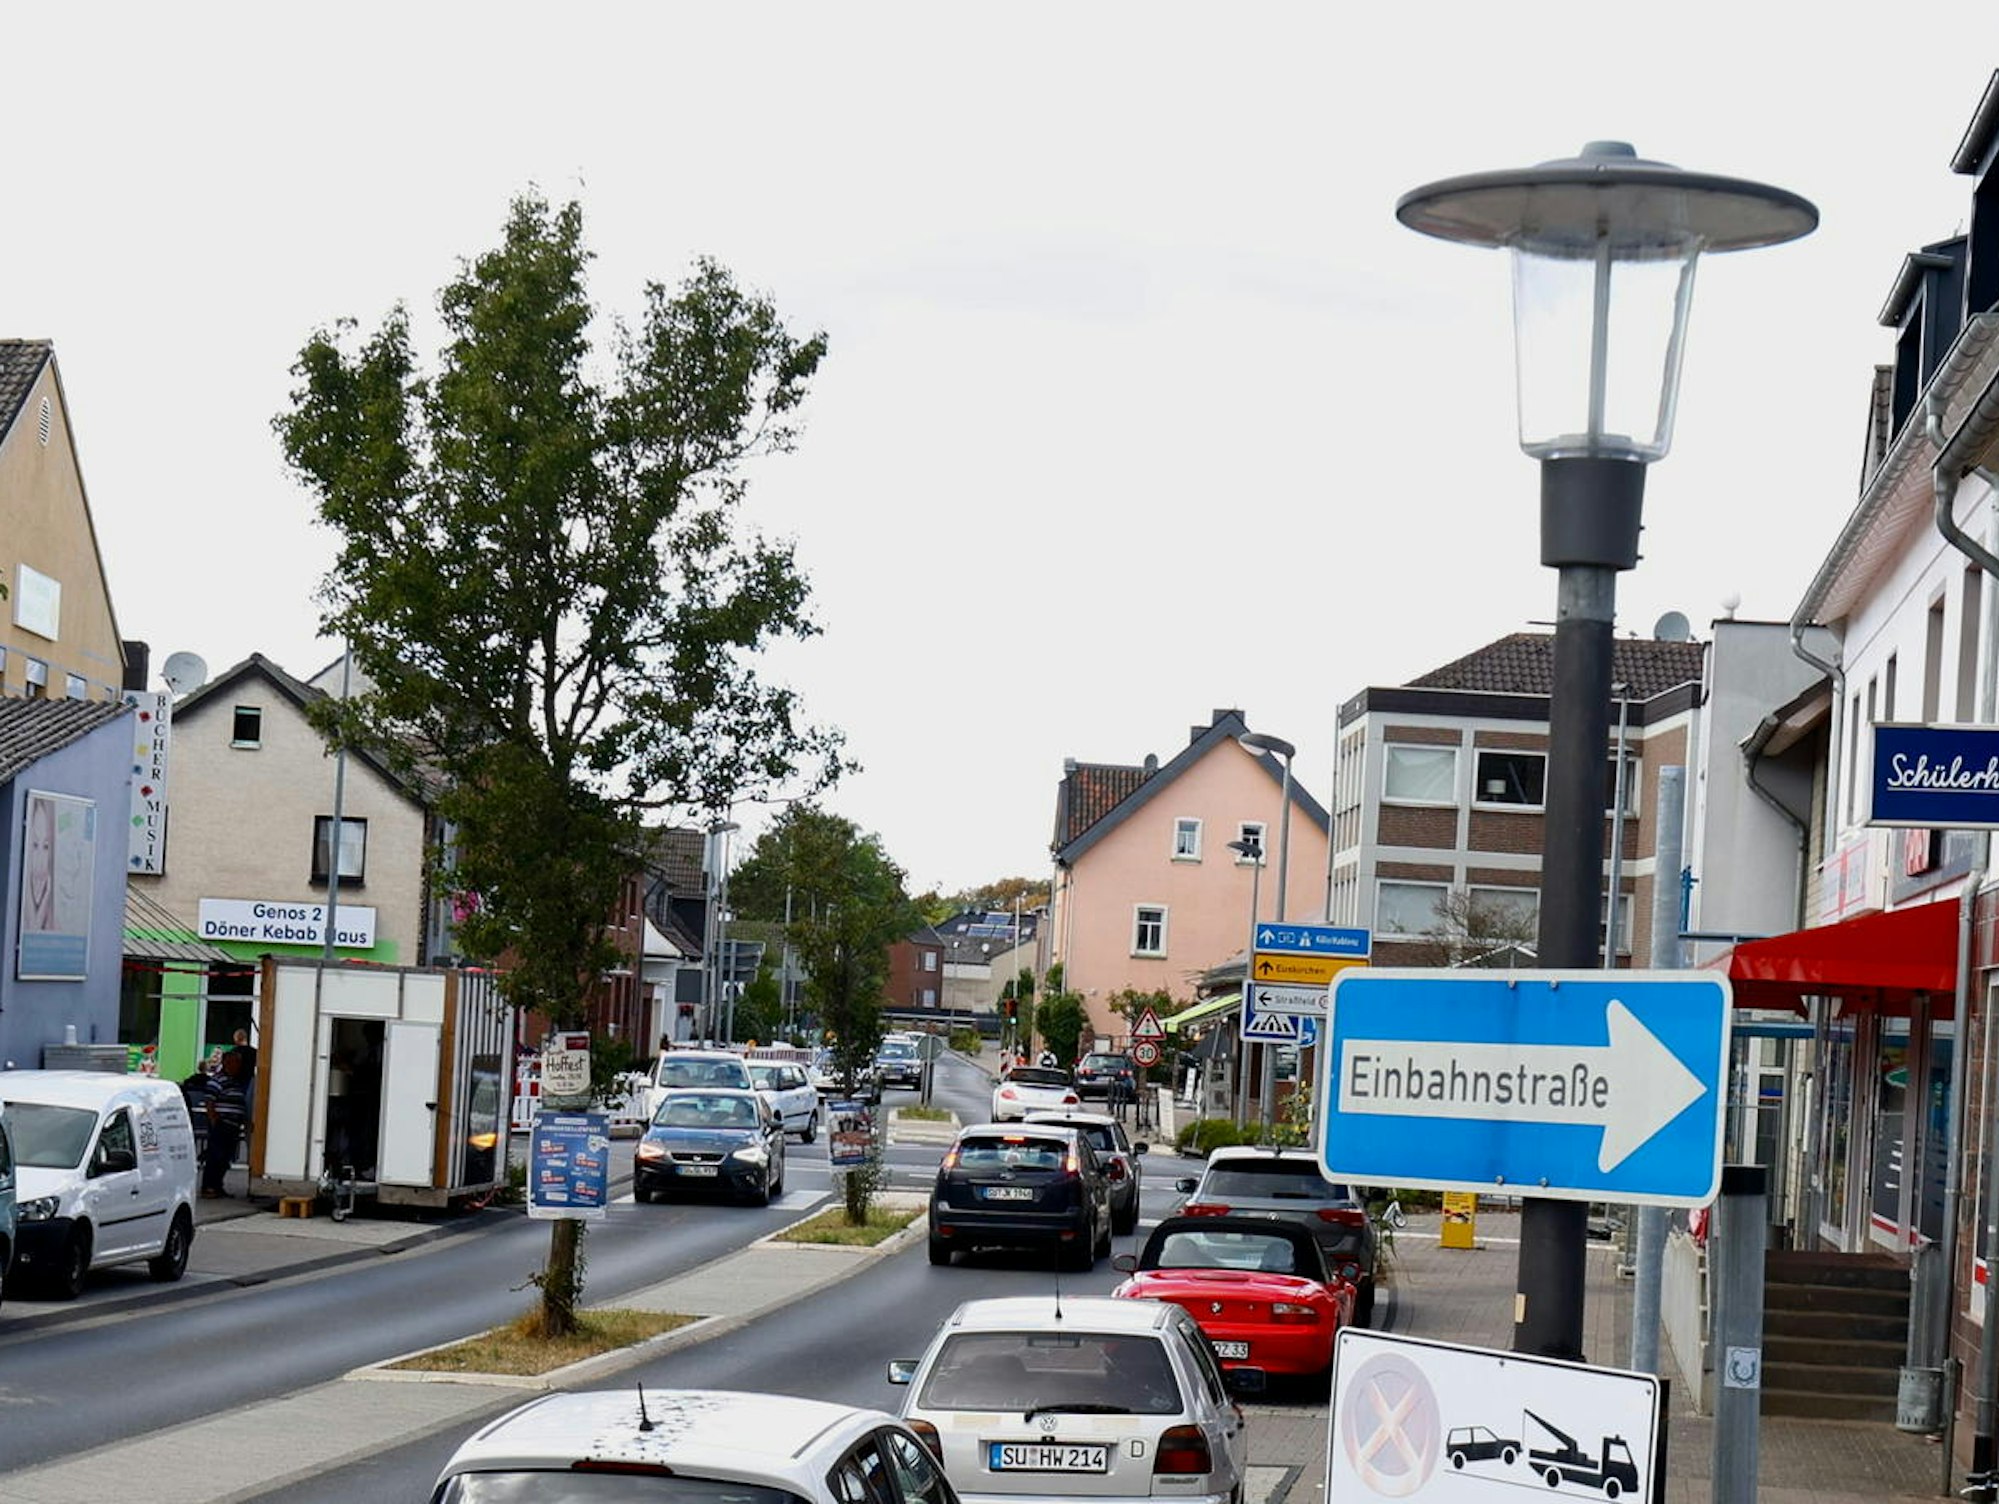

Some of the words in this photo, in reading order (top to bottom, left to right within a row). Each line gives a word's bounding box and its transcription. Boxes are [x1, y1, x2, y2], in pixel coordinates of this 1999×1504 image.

[145, 800, 161, 871] MUSIK
[253, 903, 307, 921] Genos
[312, 907, 322, 921] 2
[205, 920, 257, 938] Döner
[263, 924, 318, 942] Kebab
[325, 927, 367, 944] aus
[1276, 964, 1326, 975] Euskirchen
[1140, 1047, 1154, 1059] 30
[546, 1055, 586, 1073] Hoffest
[1350, 1055, 1610, 1108] Einbahnstraße
[1231, 1344, 1247, 1357] 33
[1002, 1447, 1027, 1466] SU
[1040, 1448, 1064, 1467] HW
[1068, 1449, 1104, 1468] 214
[1131, 1440, 1145, 1458] D
